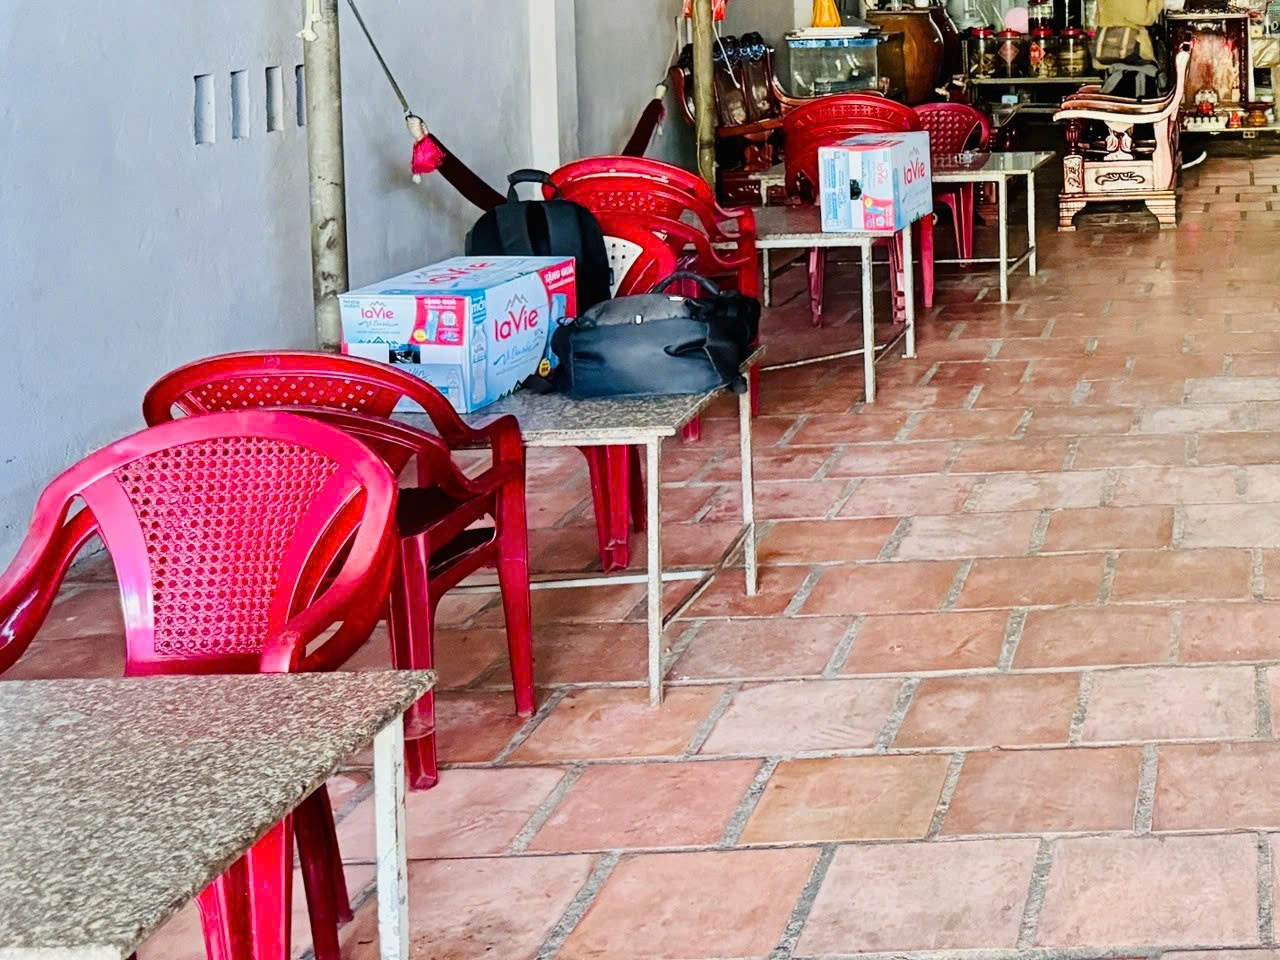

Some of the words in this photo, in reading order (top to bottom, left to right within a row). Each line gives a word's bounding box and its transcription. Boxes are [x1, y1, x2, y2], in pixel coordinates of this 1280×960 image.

[903, 157, 926, 185] laVie
[361, 307, 394, 319] laVie
[493, 305, 538, 342] laVie
